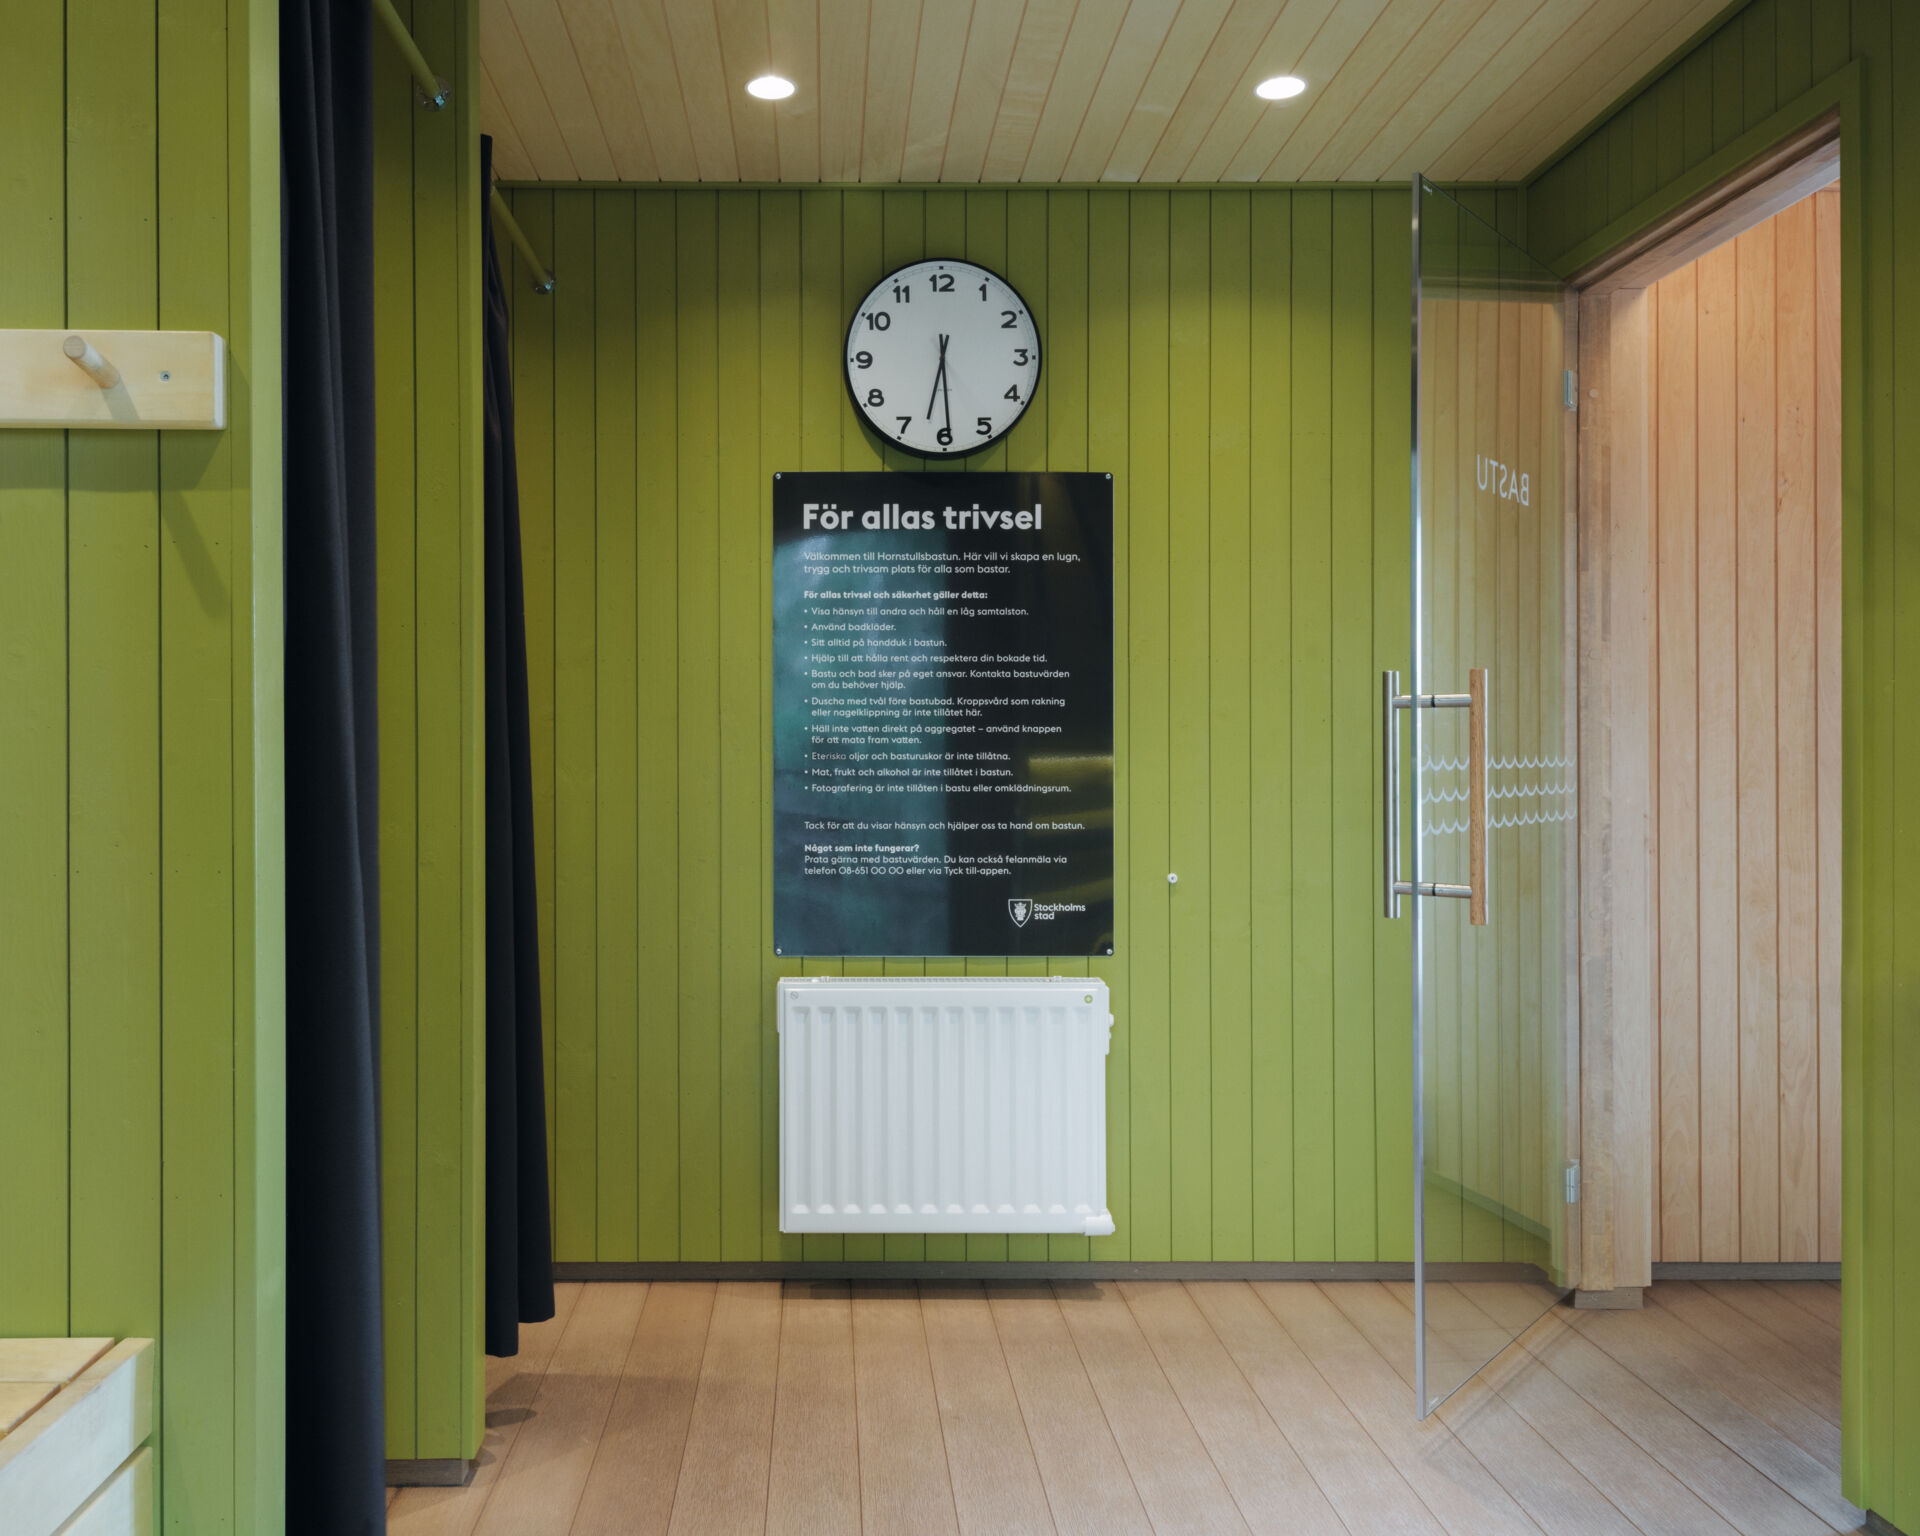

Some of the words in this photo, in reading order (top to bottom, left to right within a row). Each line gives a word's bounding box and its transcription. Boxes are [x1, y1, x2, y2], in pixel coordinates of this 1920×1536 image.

[929, 274, 955, 292] 12
[893, 285, 910, 303] 11
[979, 284, 987, 301] 1
[866, 312, 890, 331] 10
[1001, 311, 1017, 328] 2
[856, 351, 873, 369] 9
[1013, 349, 1028, 366] 3
[868, 389, 884, 407] 8
[1004, 385, 1020, 402] 4
[896, 417, 912, 434] 7
[976, 417, 992, 435] 5
[937, 428, 953, 445] 6
[803, 503, 854, 530] För
[861, 503, 935, 530] allas
[943, 503, 1042, 530] trivsel
[803, 552, 861, 561] Välkommen
[863, 552, 875, 561] till
[877, 552, 961, 561] Hornstullsbastun.
[963, 552, 982, 561] Här
[984, 552, 998, 561] vill
[999, 552, 1008, 561] vi
[1010, 552, 1040, 563] skapa
[1057, 552, 1081, 563] lugn,
[804, 566, 830, 575] trygg
[832, 564, 850, 573] och
[852, 564, 889, 573] trivsam
[891, 564, 916, 575] plats
[917, 564, 932, 573] för
[934, 564, 952, 574] alla
[954, 566, 975, 574] som
[977, 564, 1011, 574] bastar.
[843, 591, 871, 599] trivsel
[873, 591, 890, 599] och
[892, 591, 931, 599] säkerhet
[933, 591, 960, 600] gäller
[961, 591, 988, 599] detta:
[811, 607, 830, 615] Visa
[832, 608, 864, 616] hänsyn
[866, 607, 878, 615] till
[880, 607, 907, 615] andra
[909, 607, 926, 615] och
[928, 607, 945, 615] håll
[960, 607, 975, 617] låg
[977, 607, 1029, 616] samtalston.
[811, 623, 846, 631] Använd
[848, 623, 896, 631] badkläder.
[812, 670, 837, 678] Bastu
[839, 670, 856, 678] och
[858, 670, 876, 678] bad
[878, 670, 896, 678] sker
[898, 669, 911, 679] på
[913, 670, 933, 679] eget
[970, 669, 1011, 678] Kontakta
[1013, 669, 1070, 678] bastuvärden
[828, 681, 840, 689] du
[842, 680, 879, 689] behöver
[881, 680, 906, 690] hjälp.
[812, 697, 845, 705] Duscha
[847, 697, 867, 705] med
[869, 697, 886, 705] tvål
[888, 697, 907, 705] före
[909, 697, 955, 705] bastubad.
[957, 697, 1009, 707] Kroppsvård
[1031, 697, 1066, 707] rakning
[811, 708, 831, 717] eller
[833, 708, 900, 718] nagelklippning
[914, 708, 932, 717] inte
[933, 708, 963, 717] tillåtet
[965, 708, 983, 717] här.
[851, 725, 879, 733] vatten
[881, 724, 908, 733] direkt
[910, 724, 922, 734] på
[924, 725, 976, 735] aggregatet
[986, 725, 1020, 733] använd
[1022, 724, 1062, 734] knappen
[811, 735, 824, 744] för
[826, 736, 839, 744] att
[841, 736, 865, 744] mata
[867, 735, 889, 744] fram
[891, 736, 922, 744] vatten.
[812, 752, 847, 760] Eteriska
[848, 752, 869, 761] oljor
[871, 752, 888, 760] och
[890, 752, 943, 760] basturuskor
[944, 752, 955, 760] är
[956, 752, 974, 760] inte
[976, 752, 1011, 760] tillåtna.
[812, 768, 832, 777] Mat,
[834, 768, 856, 776] frukt
[858, 768, 875, 776] och
[877, 768, 910, 776] alkohol
[911, 768, 922, 776] är
[924, 768, 941, 776] inte
[943, 768, 973, 776] tillåtet
[980, 768, 1013, 776] bastun.
[811, 784, 873, 794] Fotografering
[875, 784, 885, 792] är
[887, 784, 904, 792] inte
[906, 784, 938, 792] tillåten
[940, 784, 943, 792] i
[945, 784, 971, 792] bastu
[972, 784, 993, 792] eller
[994, 784, 1072, 794] omklädningsrum.
[804, 821, 825, 830] Tack
[827, 821, 840, 830] för
[842, 822, 855, 830] att
[857, 822, 869, 830] du
[870, 821, 892, 830] visar
[894, 822, 926, 831] hänsyn
[928, 821, 945, 830] och
[947, 821, 979, 831] hjälper
[997, 822, 1008, 830] ta
[1009, 821, 1033, 830] hand
[1052, 821, 1085, 830] bastun.
[804, 844, 833, 854] Något
[855, 844, 873, 852] inte
[874, 844, 920, 854] fungerar?
[804, 855, 829, 863] Prata
[831, 856, 858, 865] gärna
[860, 855, 880, 863] med
[882, 855, 942, 864] bastuvärden.
[944, 855, 956, 864] Du
[958, 855, 975, 864] kan
[977, 855, 1003, 864] också
[1005, 855, 1051, 864] felanmäla
[1053, 855, 1067, 864] via
[804, 866, 837, 875] telefon
[838, 866, 868, 875] 08-651
[870, 866, 887, 875] 00
[888, 866, 904, 875] 00
[906, 866, 926, 875] eller
[928, 866, 942, 875] via
[943, 866, 964, 876] Tyck
[965, 866, 1012, 876] till-appen.
[1034, 903, 1086, 912] Stockholms
[1034, 911, 1055, 920] stad
